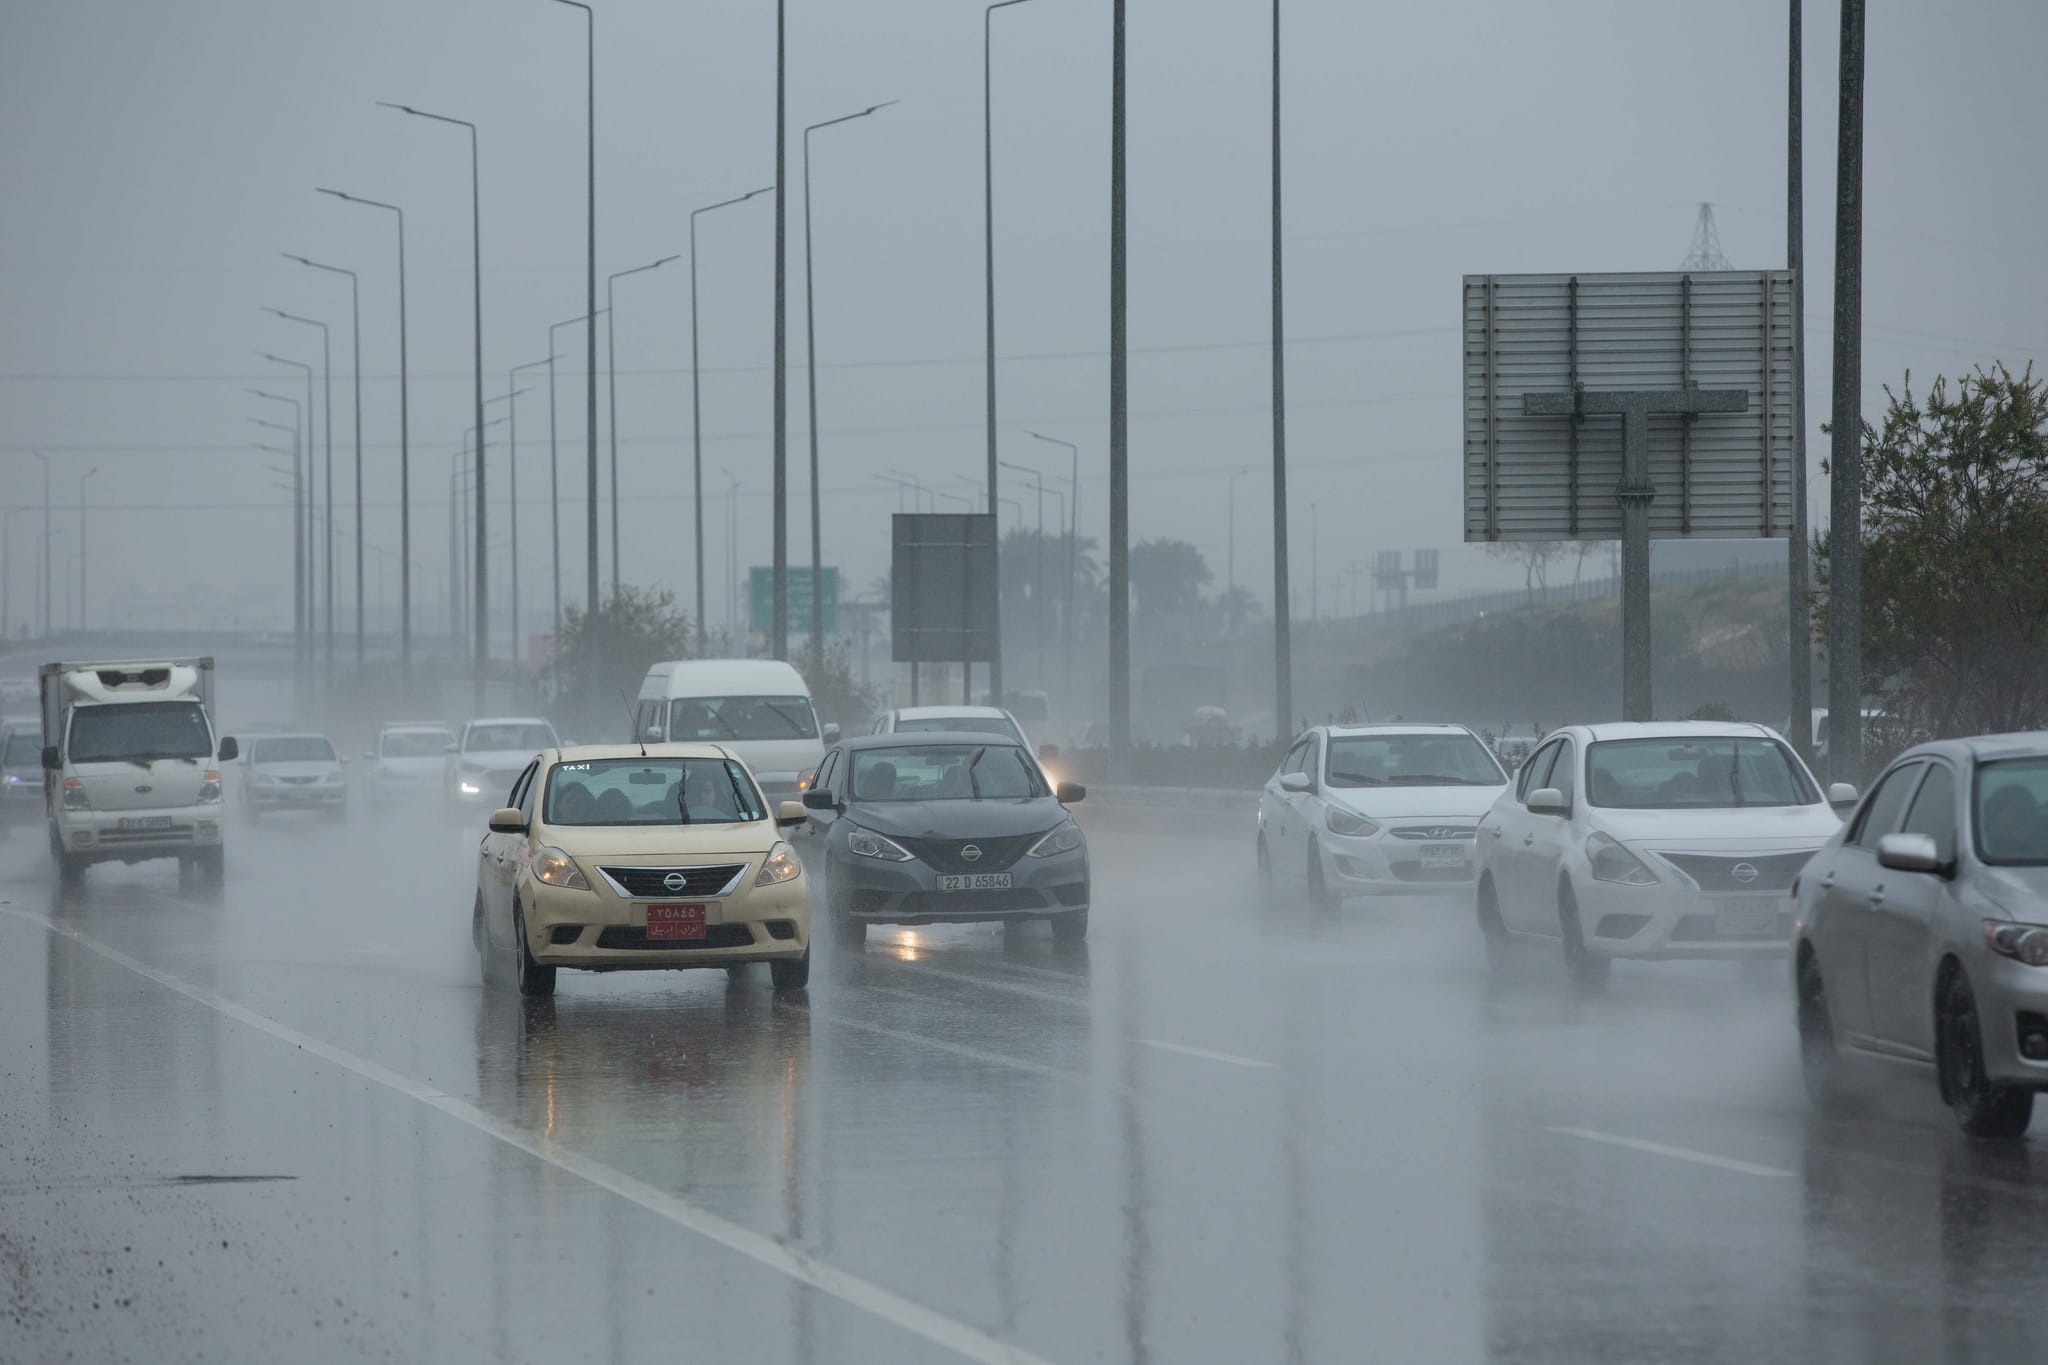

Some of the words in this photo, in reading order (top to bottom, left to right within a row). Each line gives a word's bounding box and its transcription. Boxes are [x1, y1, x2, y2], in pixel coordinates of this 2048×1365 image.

[945, 876, 960, 889] 22
[964, 876, 972, 889] D
[975, 874, 1009, 888] 65846
